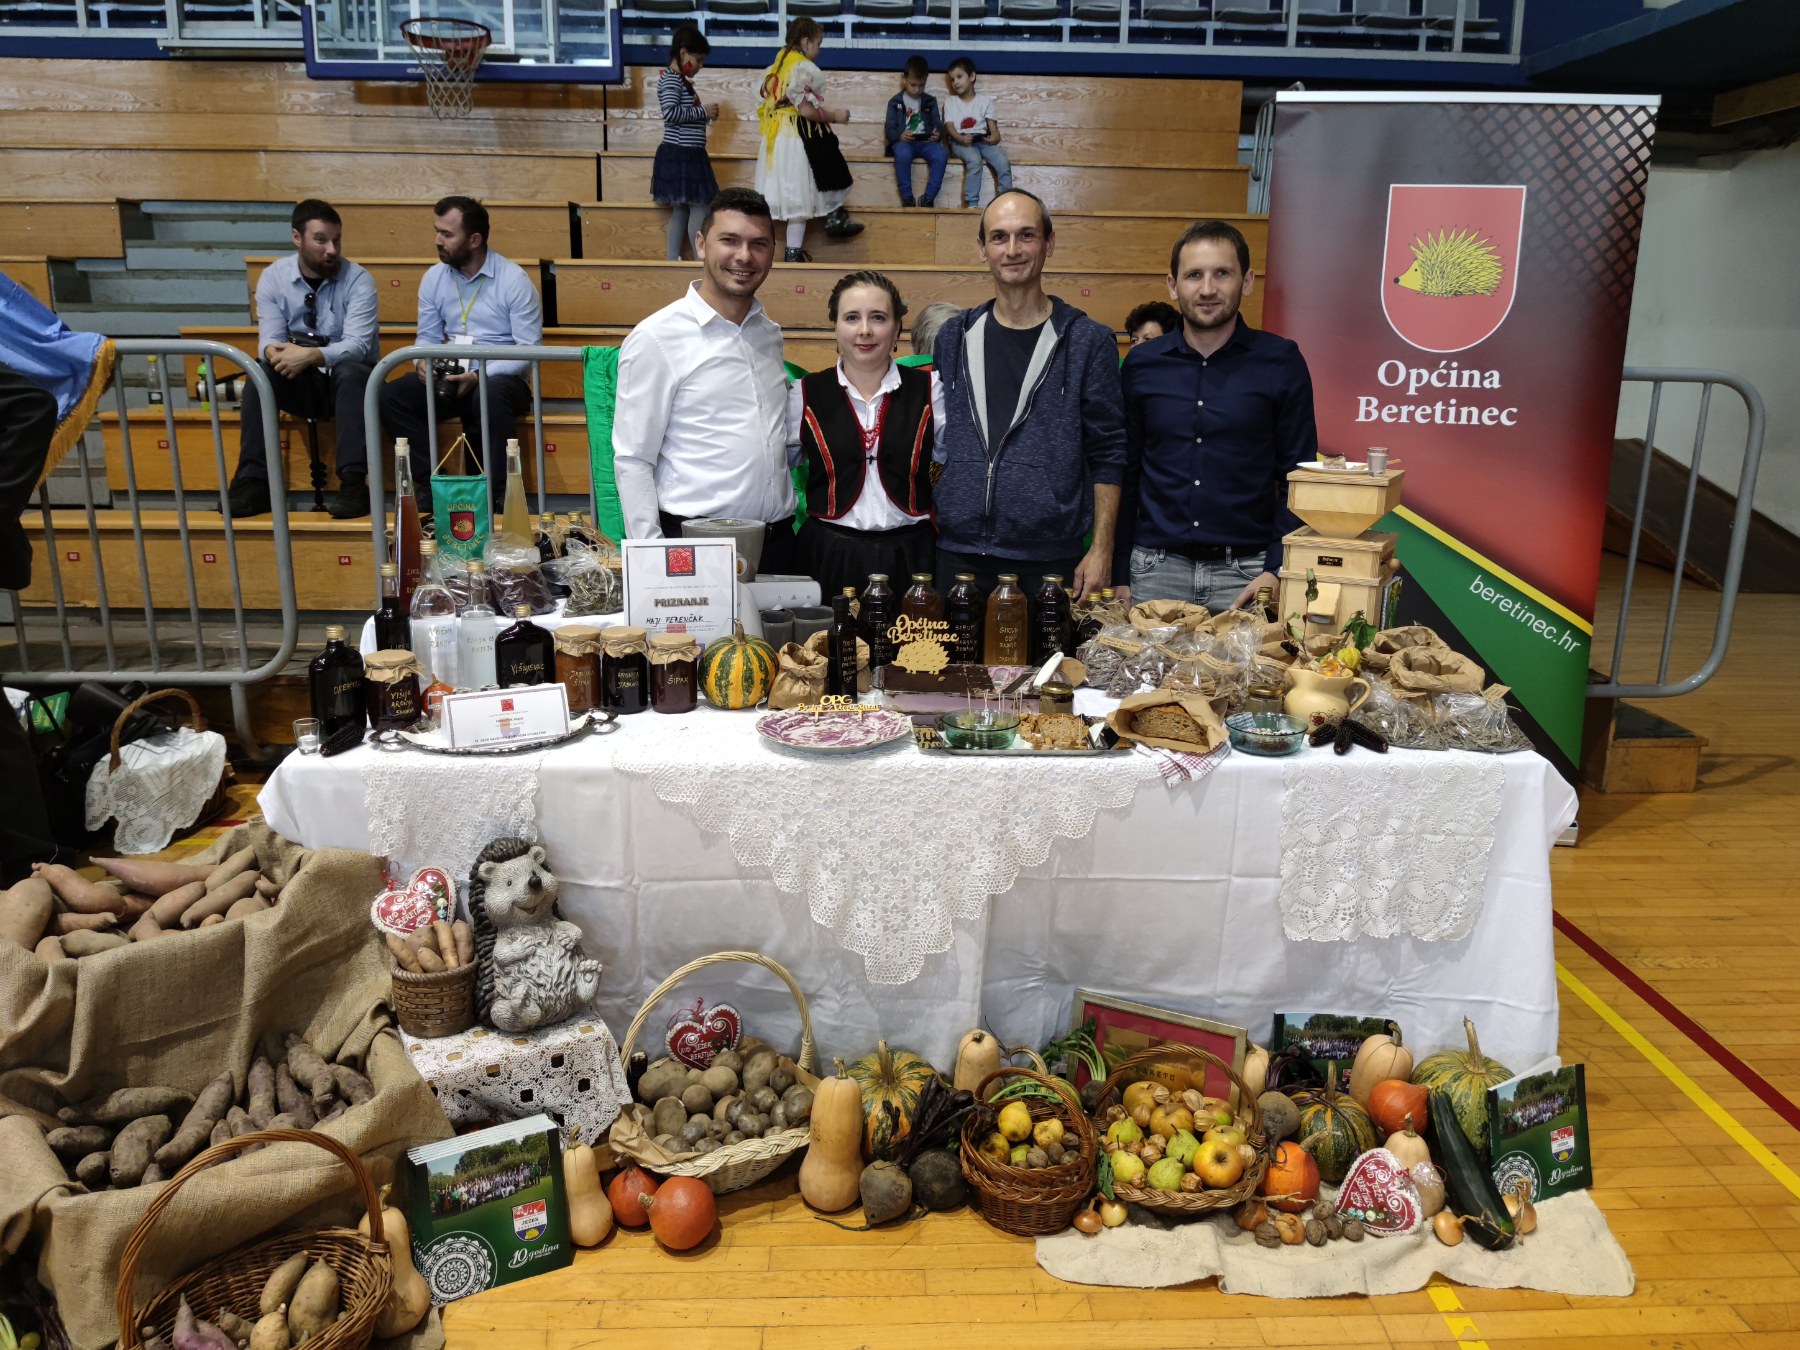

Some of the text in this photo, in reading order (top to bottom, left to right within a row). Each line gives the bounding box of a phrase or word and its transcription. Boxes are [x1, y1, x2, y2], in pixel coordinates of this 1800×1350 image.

[1377, 360, 1502, 395] Općina
[1355, 396, 1518, 427] Beretinec
[654, 596, 709, 608] PRIZNANJE
[666, 613, 704, 624] FERENČAK
[1469, 574, 1581, 653] beretinec.hr
[895, 614, 950, 634] Općina
[886, 626, 960, 644] Beretinec
[667, 674, 689, 685] ŠIPAK
[820, 694, 853, 706] OPG
[1561, 1165, 1584, 1180] godina
[512, 1243, 560, 1265] 10 godina
